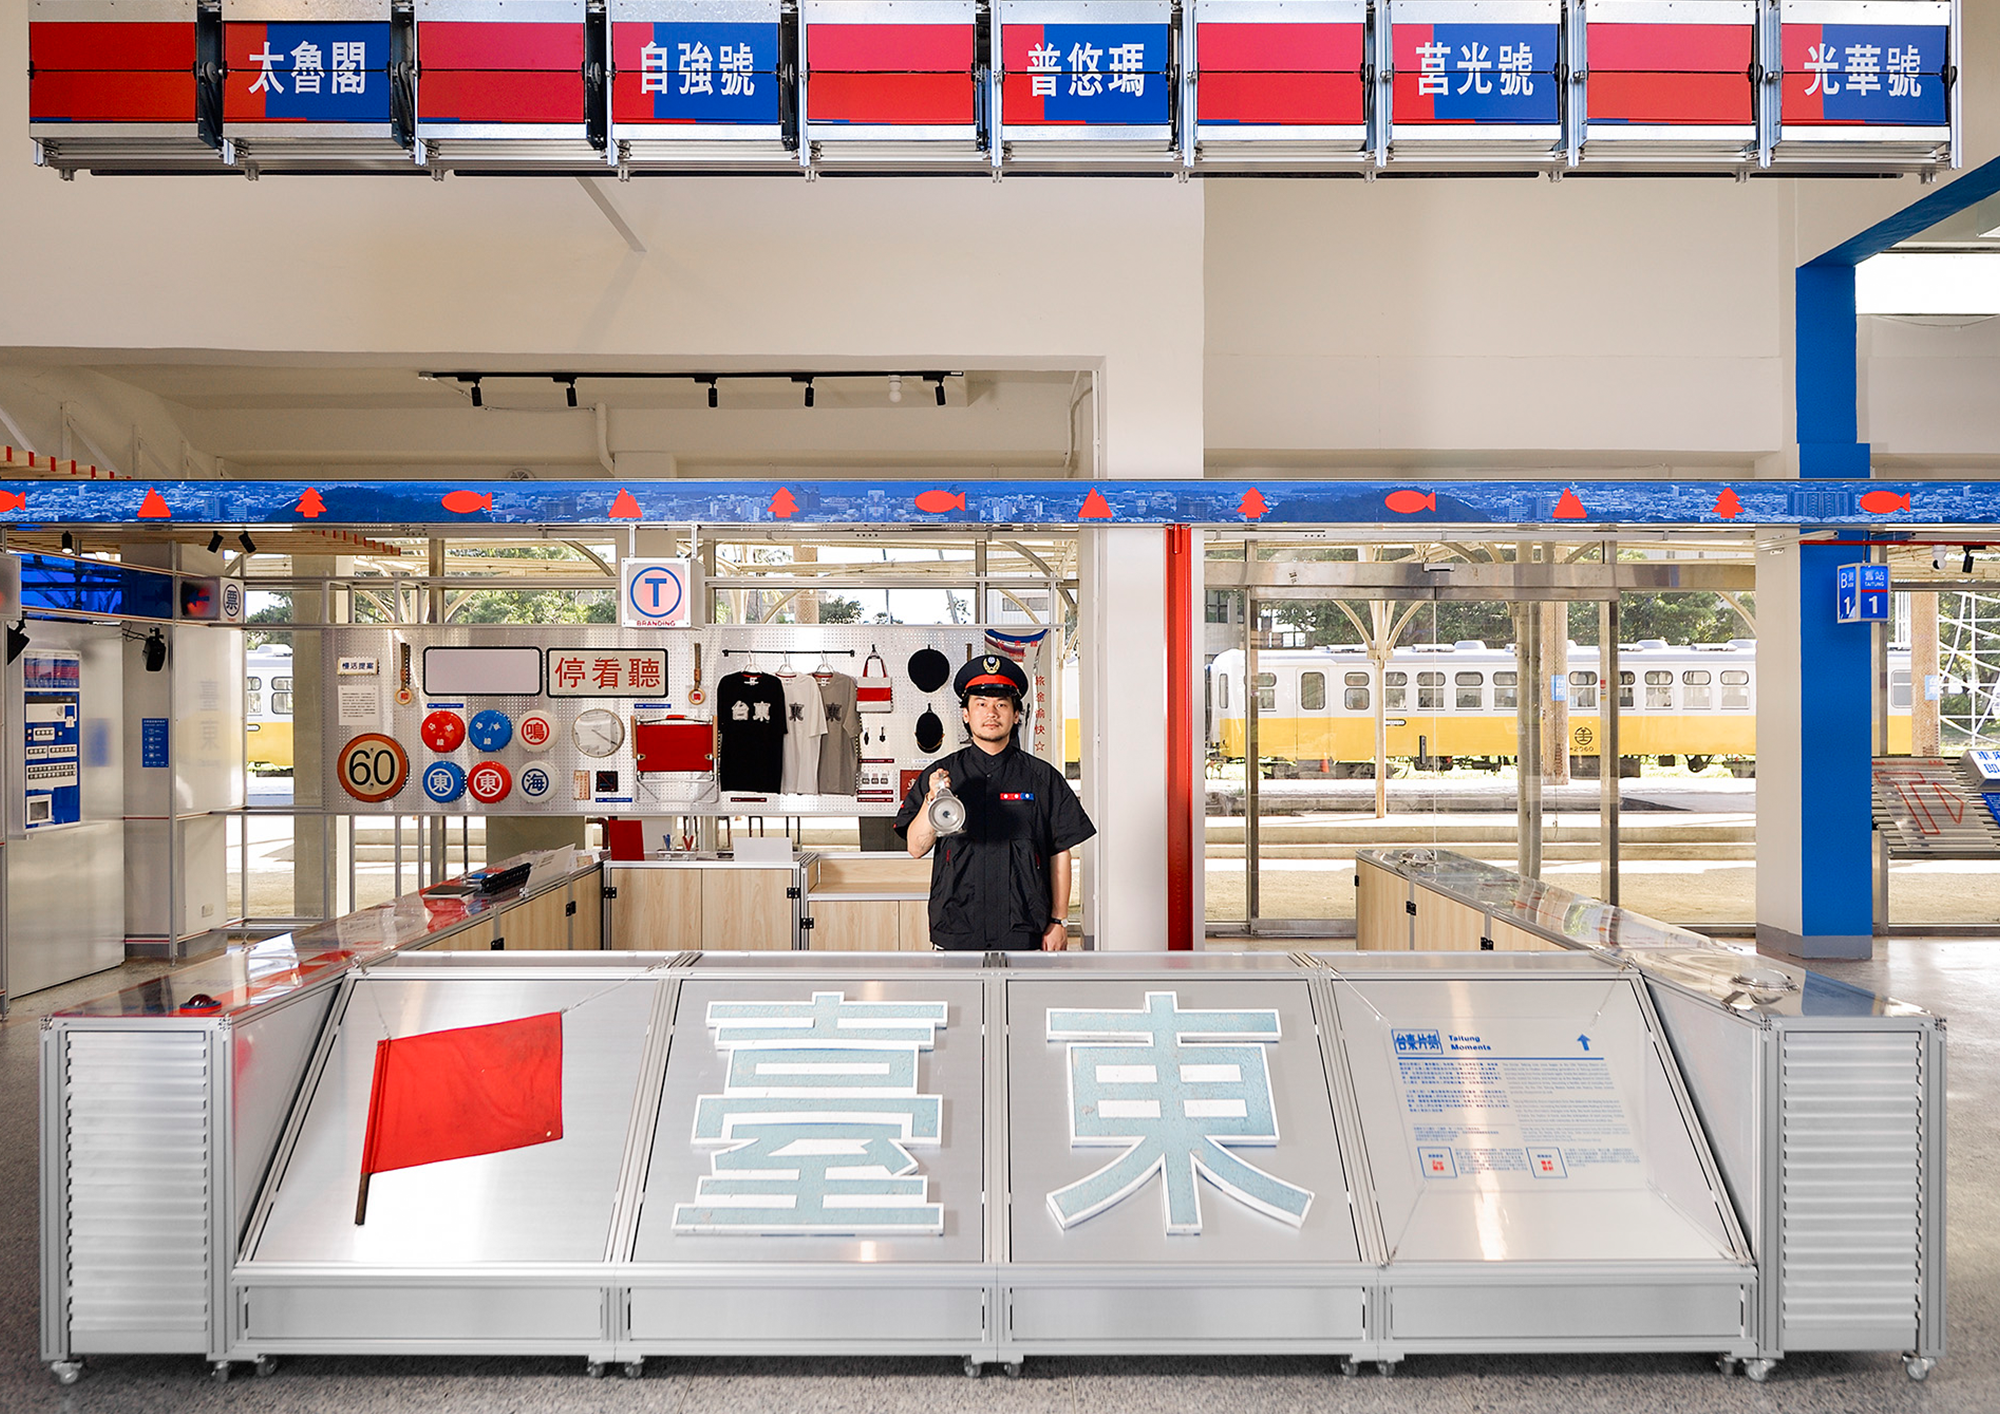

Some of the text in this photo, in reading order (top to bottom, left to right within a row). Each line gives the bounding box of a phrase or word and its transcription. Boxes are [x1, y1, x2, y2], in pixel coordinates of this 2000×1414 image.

[248, 40, 366, 95] 太魯閣
[640, 40, 755, 96] 自強號
[1026, 42, 1146, 98] 普悠瑪
[1415, 41, 1534, 97] 莒光號
[1803, 42, 1922, 97] 光華號
[226, 589, 239, 611] 票
[645, 578, 667, 607] T
[1868, 595, 1878, 614] 1
[1843, 596, 1851, 615] 1
[554, 656, 661, 689] 停看聽
[731, 700, 772, 722] 台東
[348, 749, 396, 786] 60
[431, 773, 450, 792] 東
[478, 773, 498, 792] 東
[525, 773, 545, 792] 海
[1396, 1033, 1440, 1051] 台東片刻
[1448, 1034, 1481, 1043] Taitung
[670, 990, 1316, 1237] 臺東
